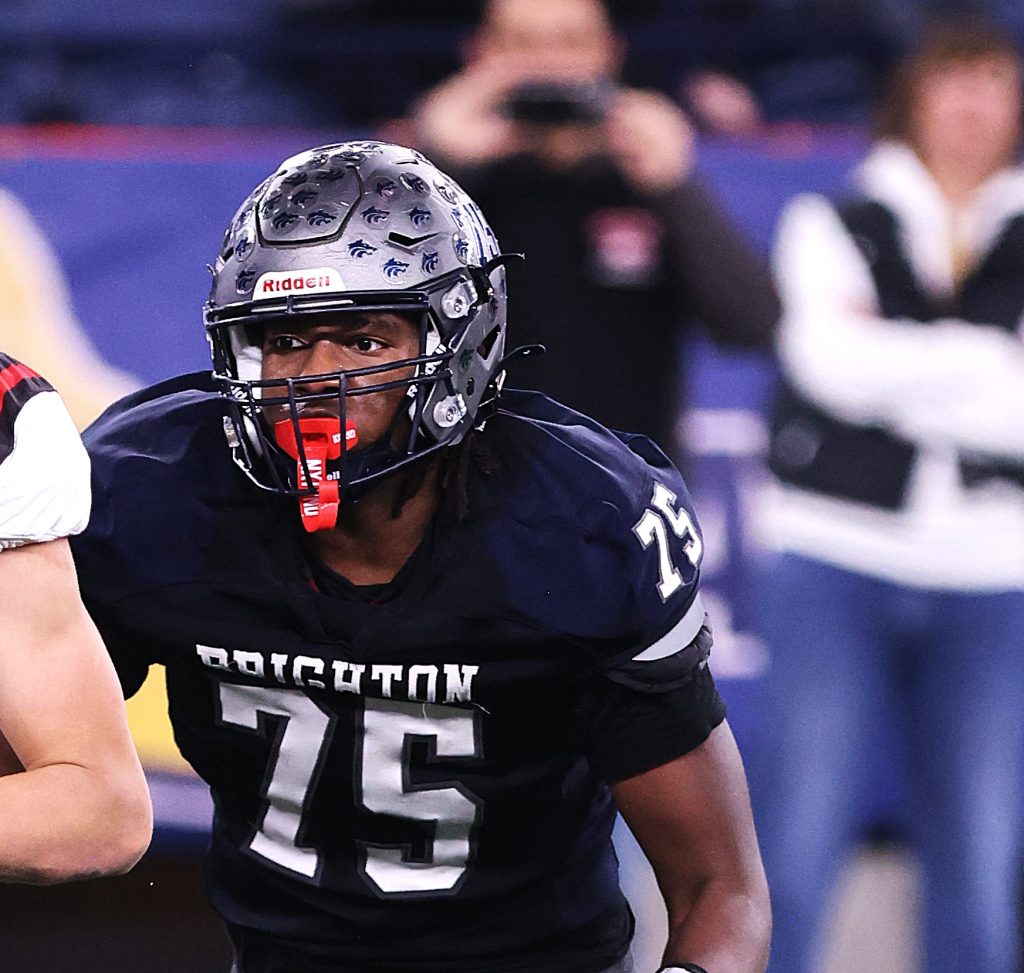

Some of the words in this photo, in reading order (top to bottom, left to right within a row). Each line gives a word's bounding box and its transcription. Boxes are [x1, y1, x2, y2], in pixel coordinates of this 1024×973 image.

[262, 276, 331, 293] Riddell
[631, 480, 705, 604] 75
[214, 681, 484, 897] 75
